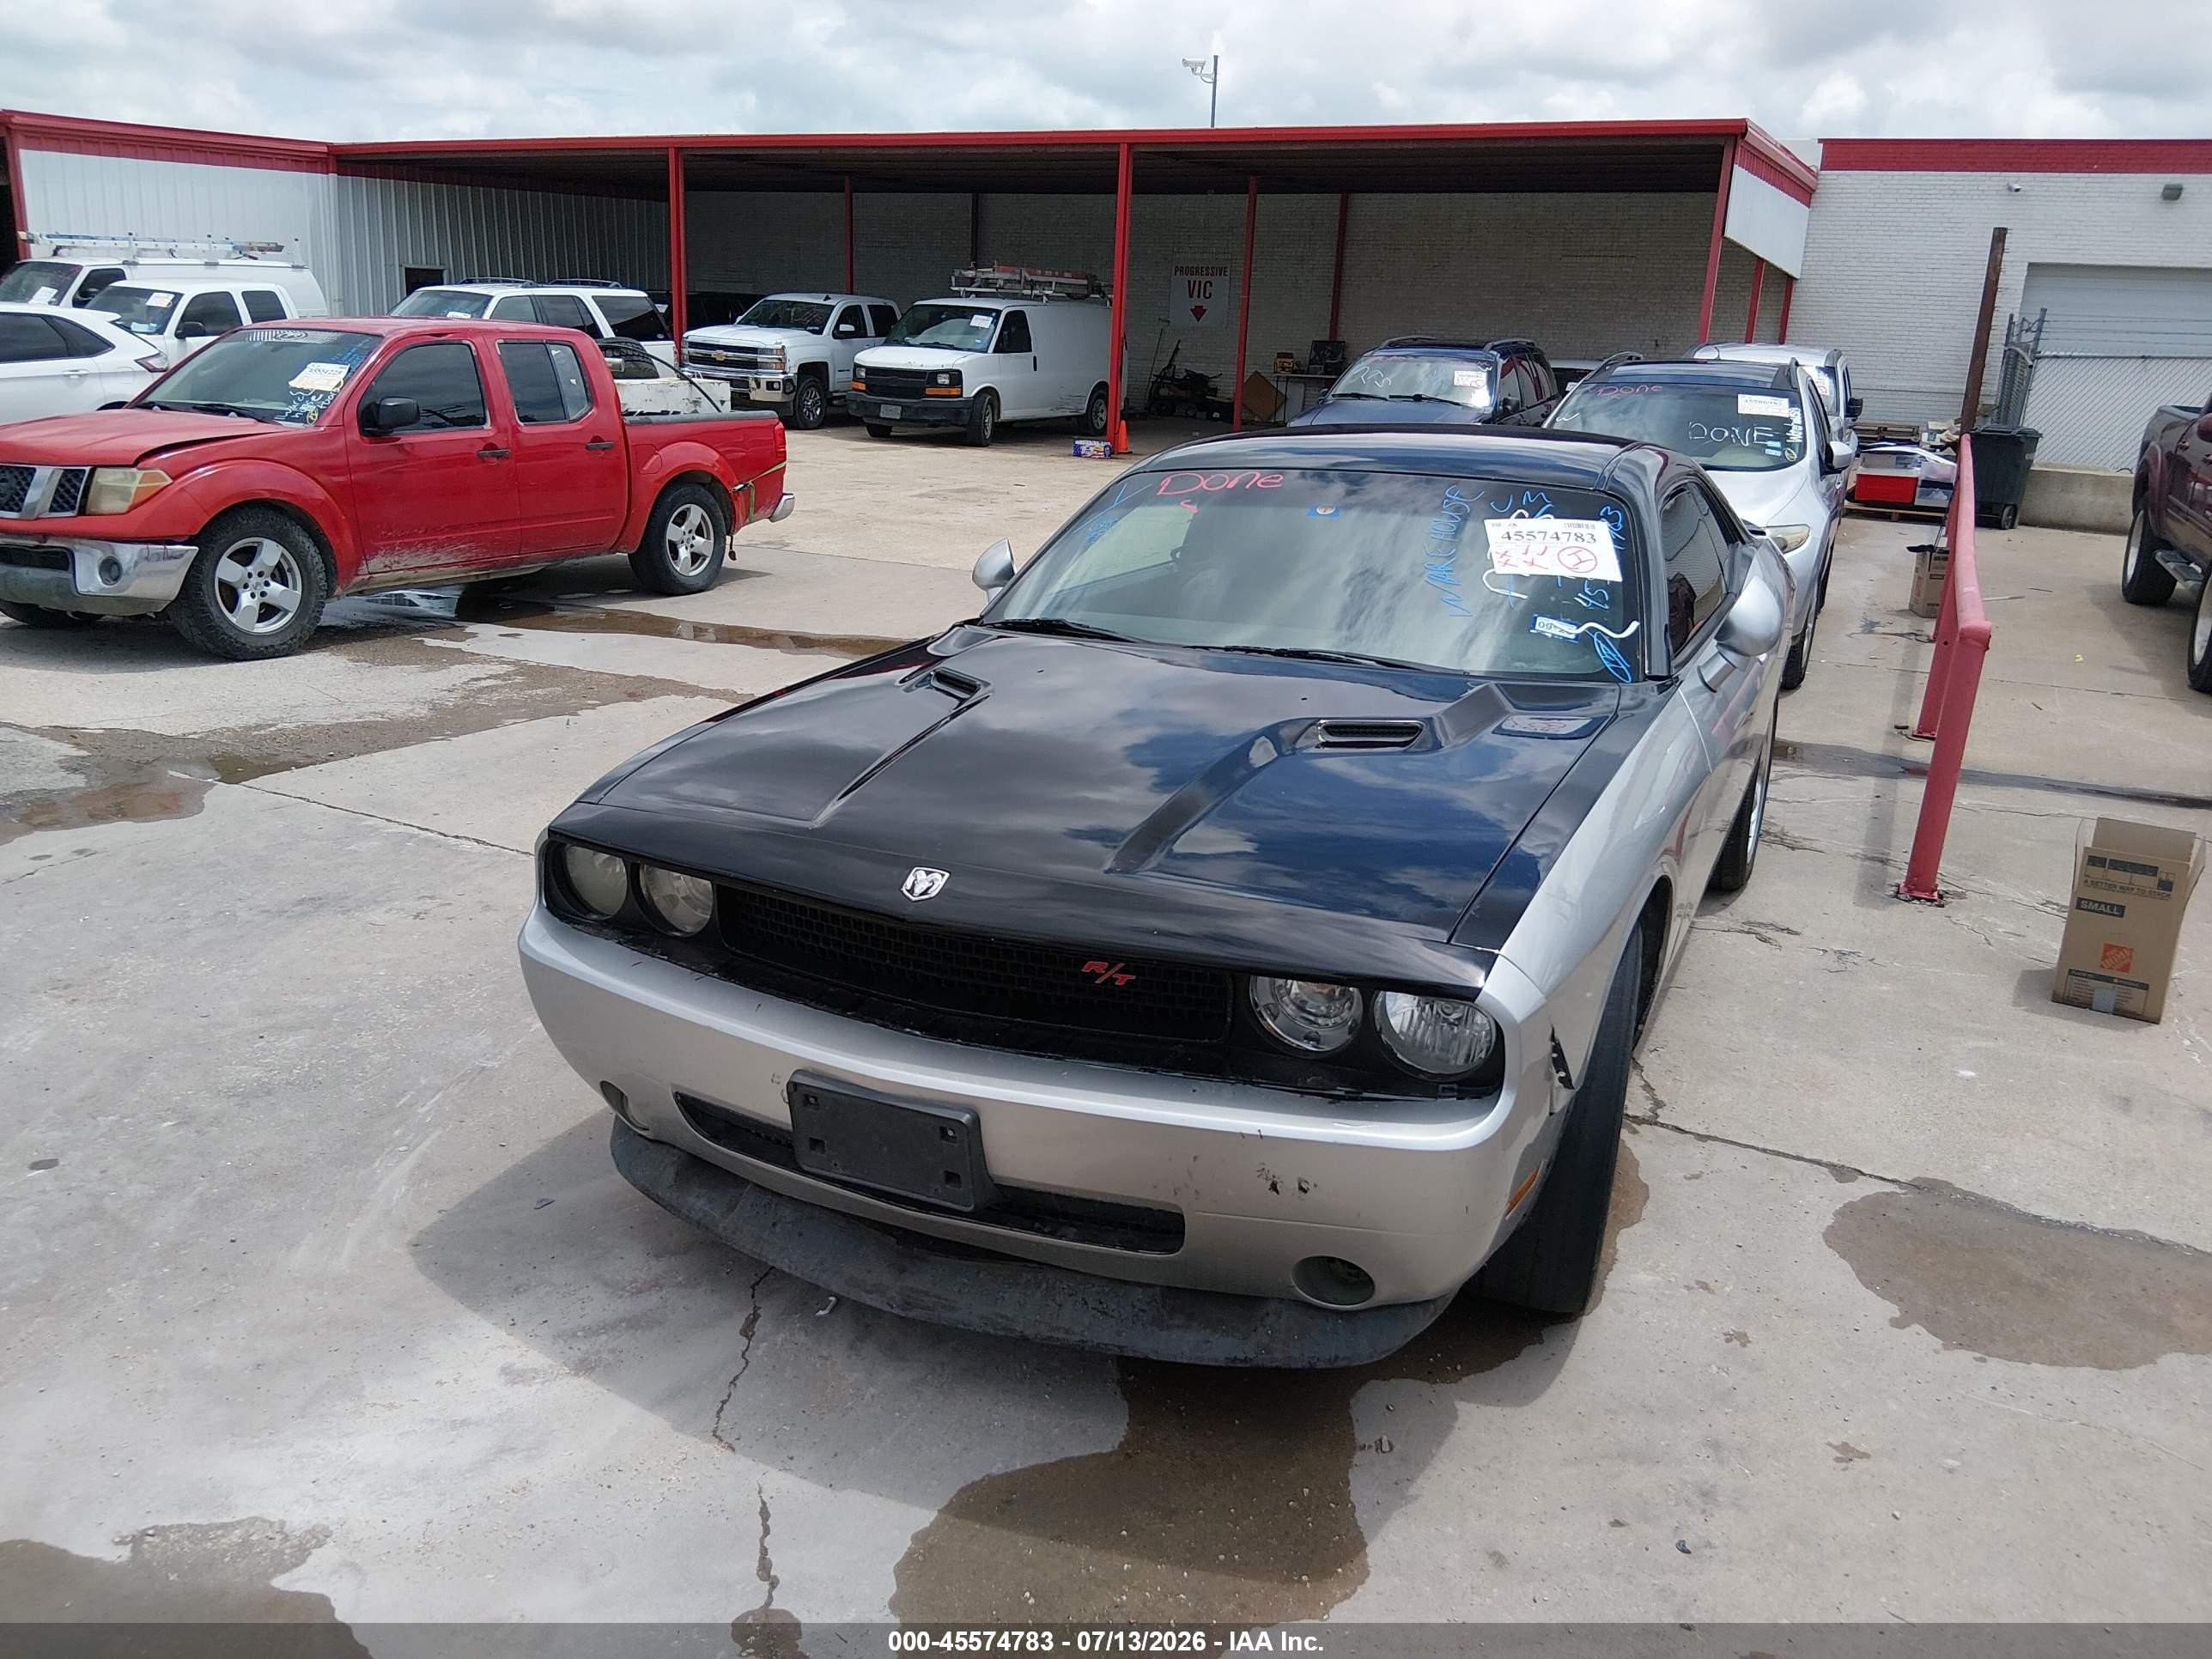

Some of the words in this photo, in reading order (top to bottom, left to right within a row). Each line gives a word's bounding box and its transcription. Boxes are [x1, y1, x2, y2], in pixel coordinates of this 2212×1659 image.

[1174, 265, 1229, 276] PROGRESSIVE
[1187, 279, 1213, 300] VIC
[1689, 421, 1774, 447] DONE
[1500, 530, 1598, 544] 45574783
[2081, 900, 2122, 915] SMALL
[1081, 961, 1137, 986] R/T
